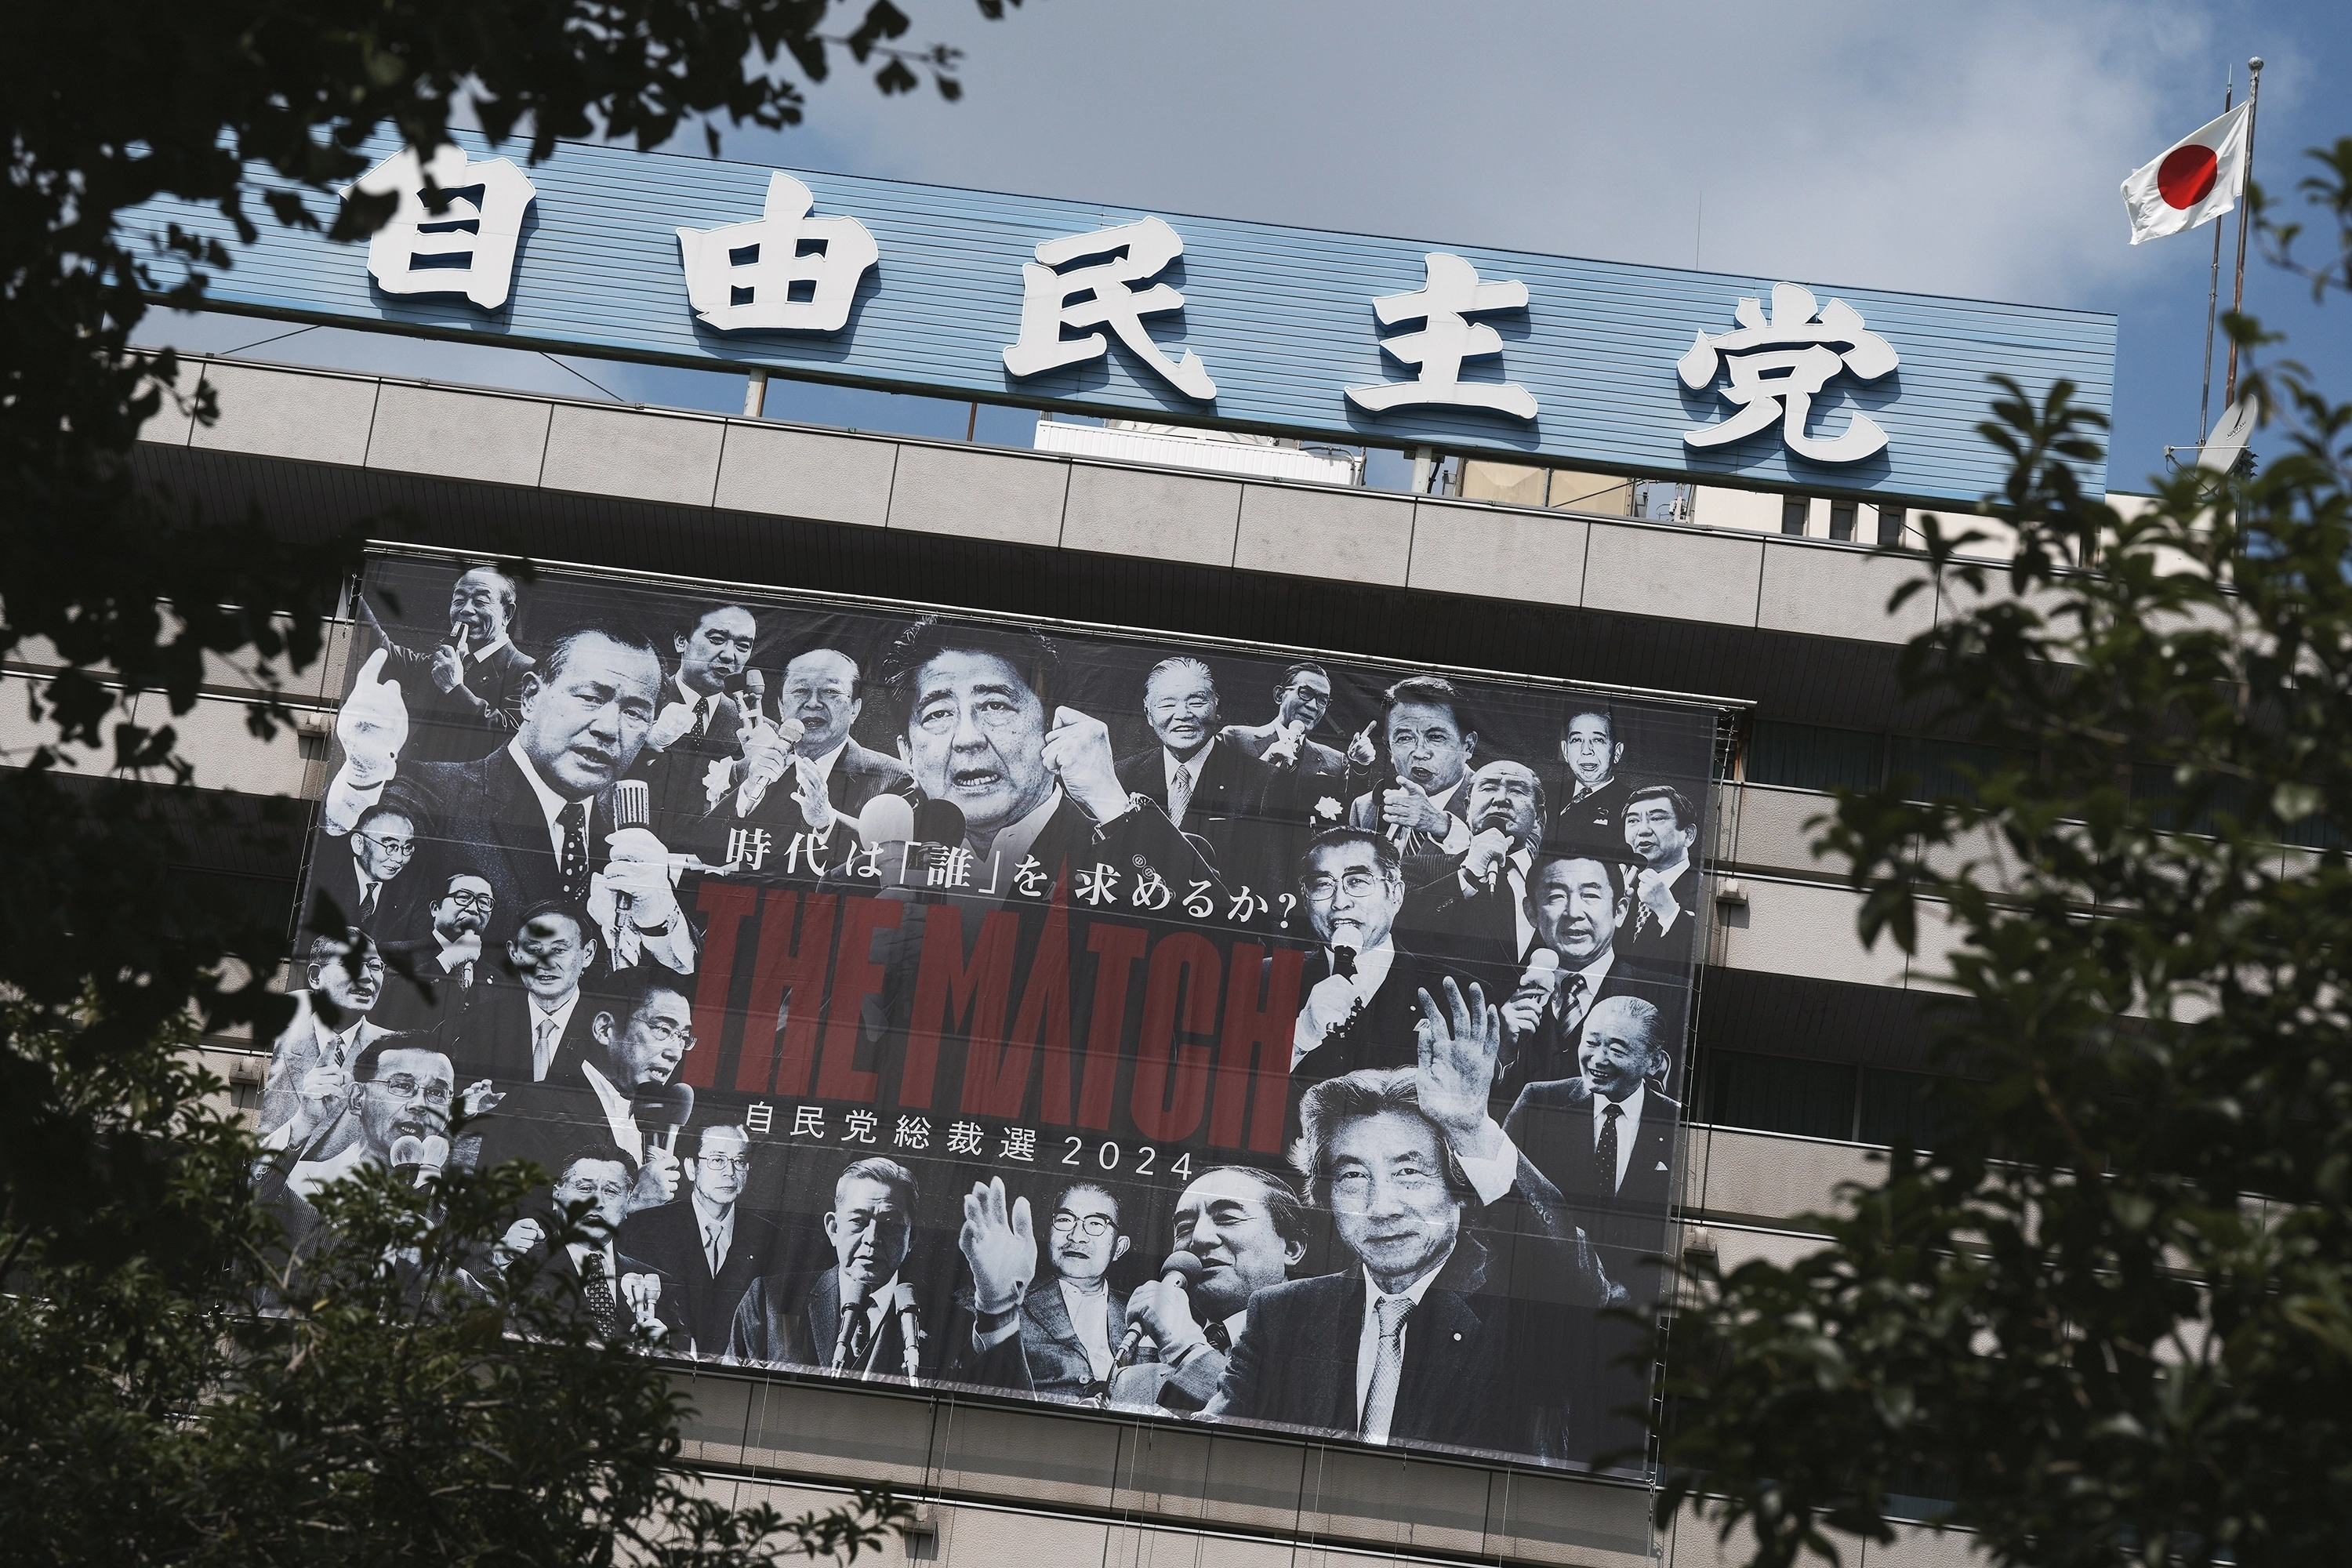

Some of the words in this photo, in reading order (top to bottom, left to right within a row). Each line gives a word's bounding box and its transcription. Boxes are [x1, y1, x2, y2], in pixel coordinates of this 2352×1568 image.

[339, 143, 1900, 463] 自由民主党
[682, 881, 904, 1102] THE
[898, 851, 1305, 1154] MATCH
